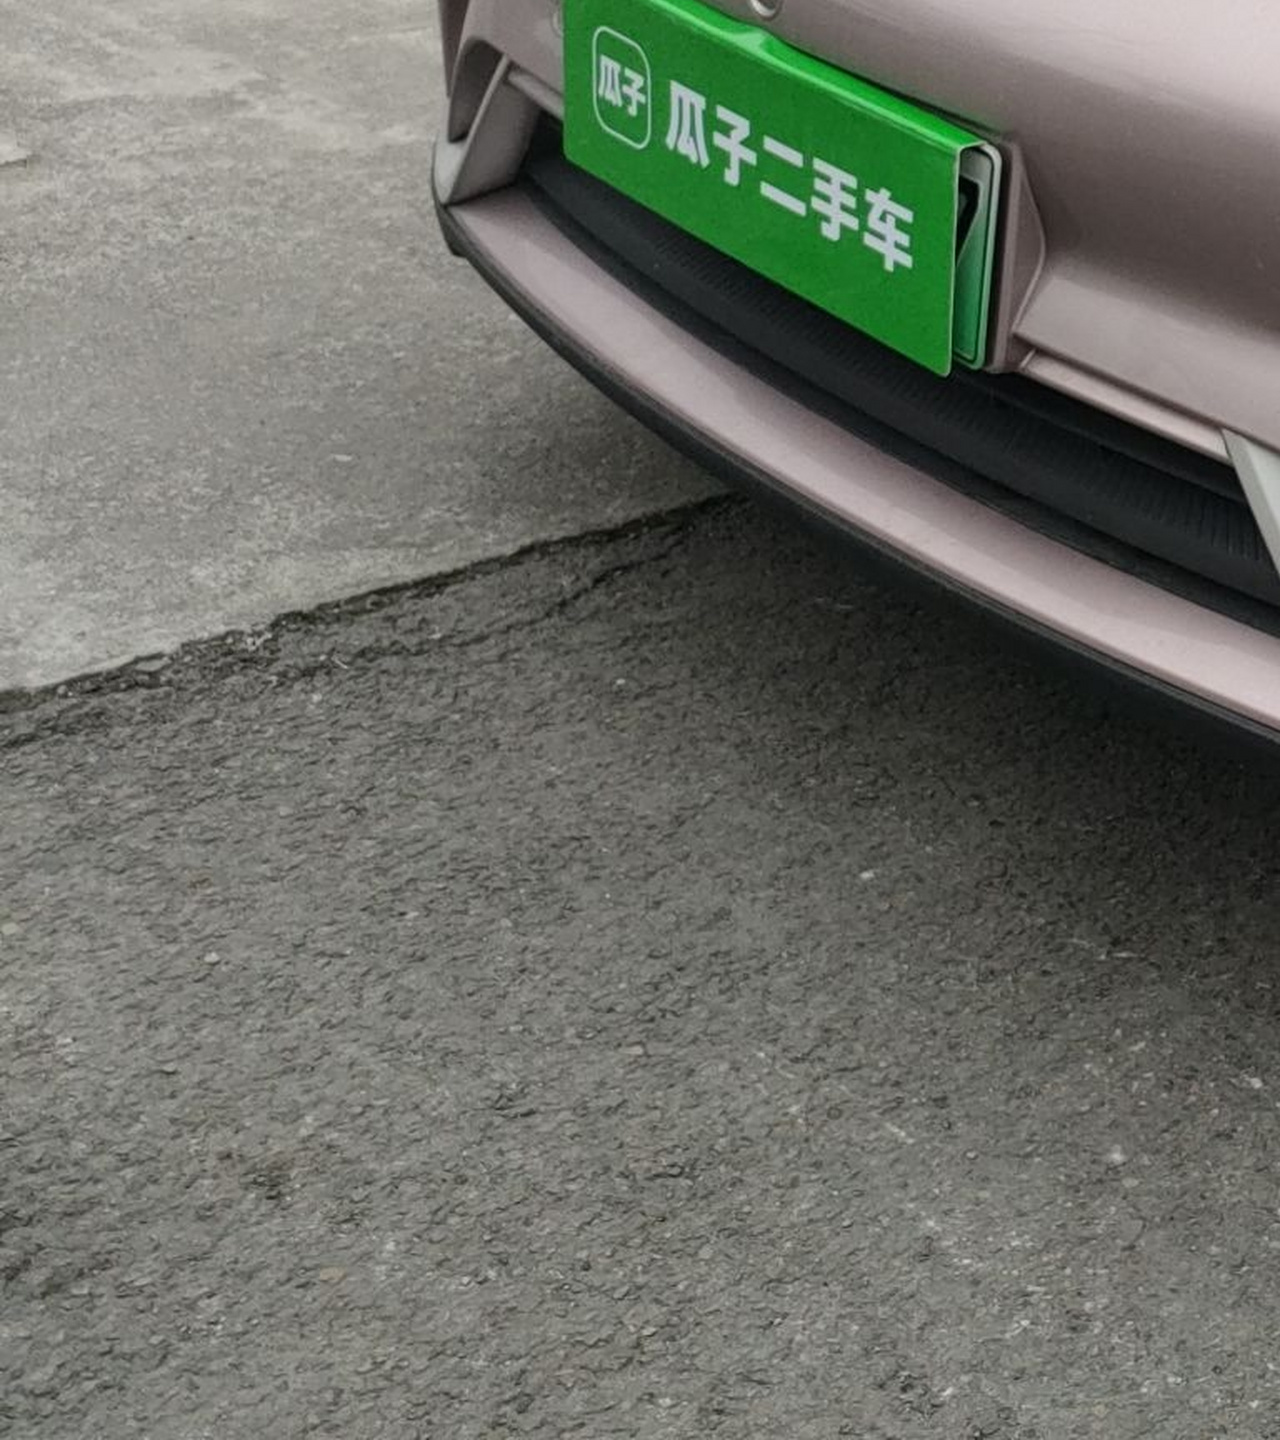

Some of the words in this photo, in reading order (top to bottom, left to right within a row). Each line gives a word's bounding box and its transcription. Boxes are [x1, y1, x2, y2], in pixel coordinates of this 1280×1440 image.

[598, 54, 647, 117] 瓜子
[665, 80, 914, 273] 瓜子二手车
